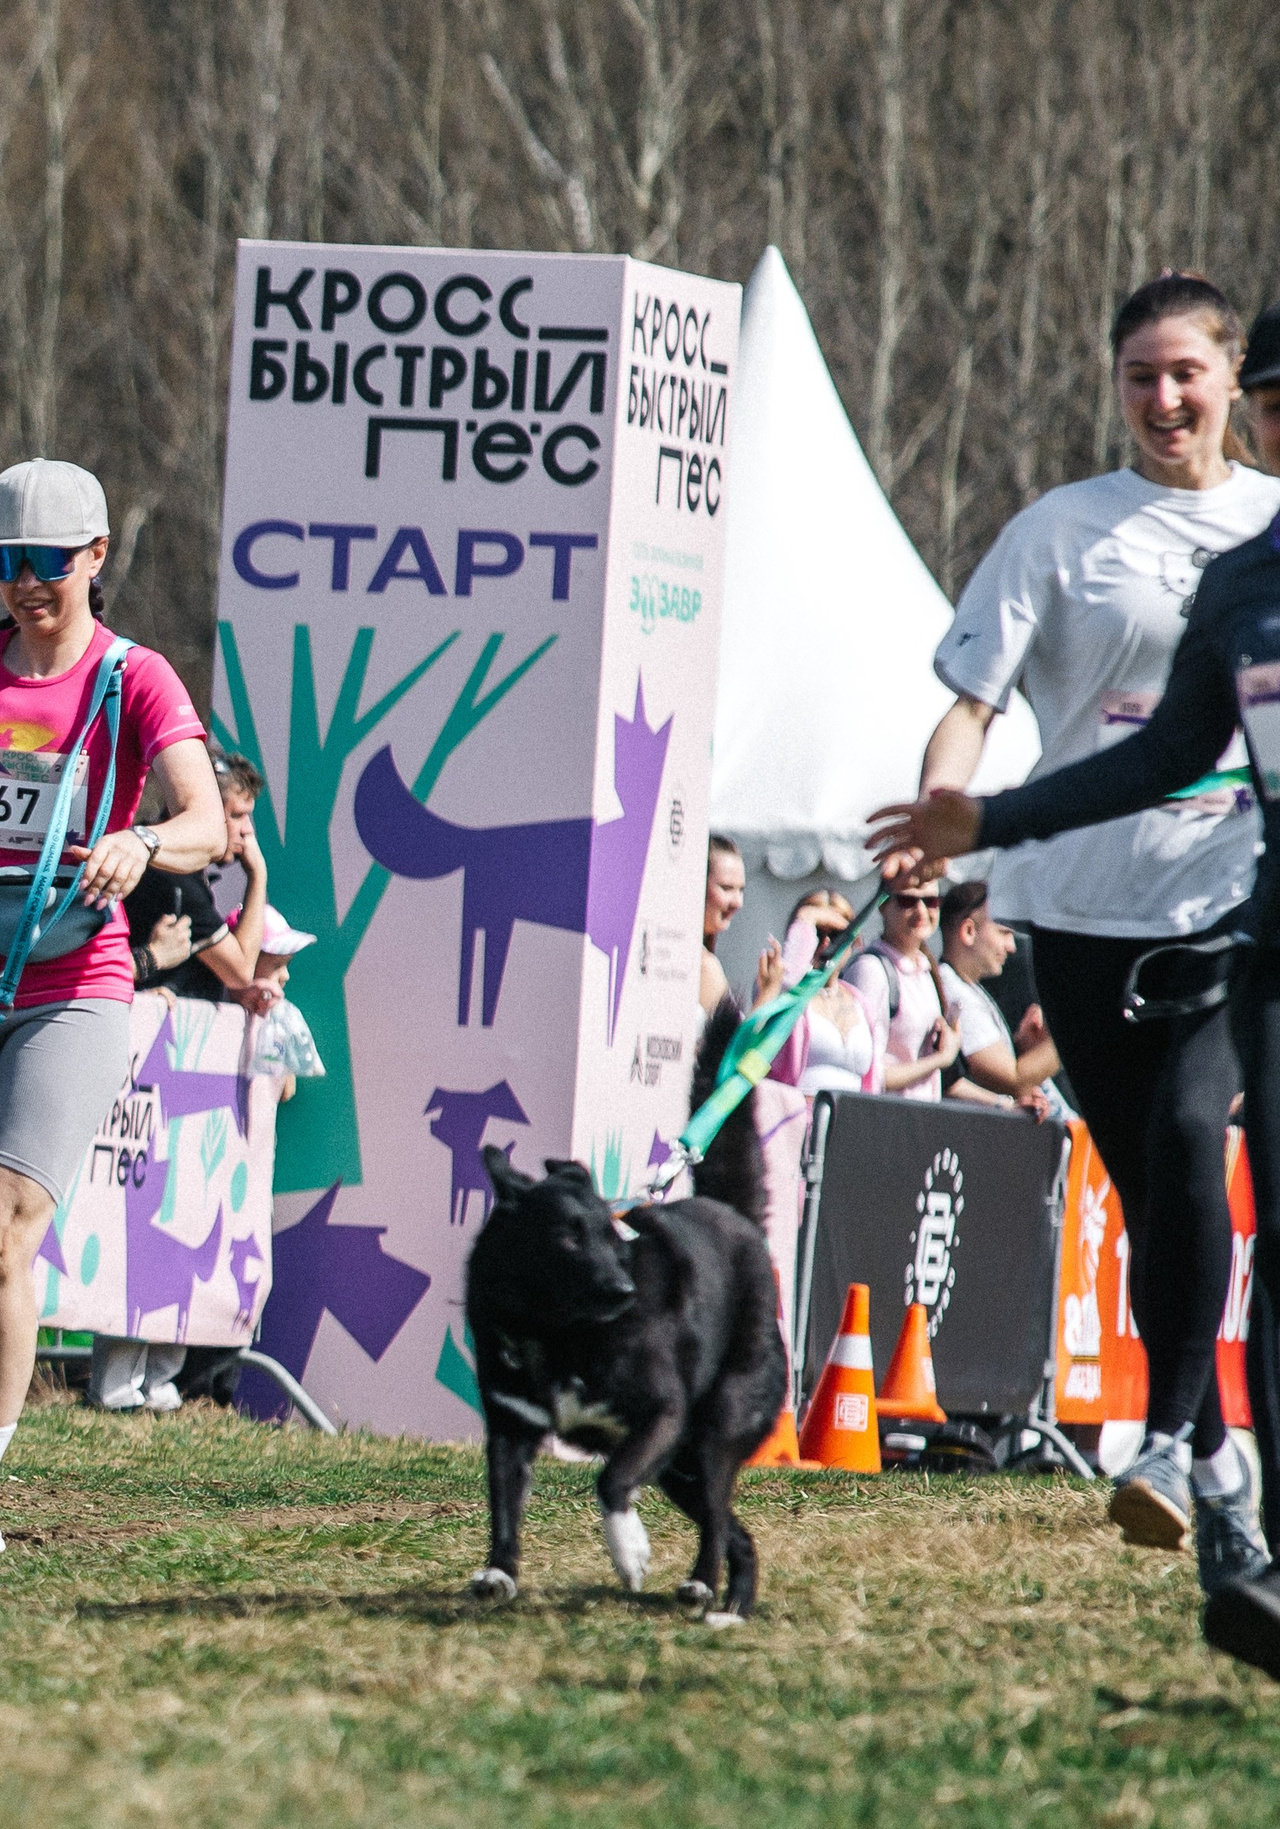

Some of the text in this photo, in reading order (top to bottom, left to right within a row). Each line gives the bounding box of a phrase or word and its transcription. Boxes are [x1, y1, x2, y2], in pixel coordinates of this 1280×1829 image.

[253, 266, 534, 340] КРОСС
[631, 291, 711, 370] КРОСС
[232, 519, 600, 600] СТАРТ
